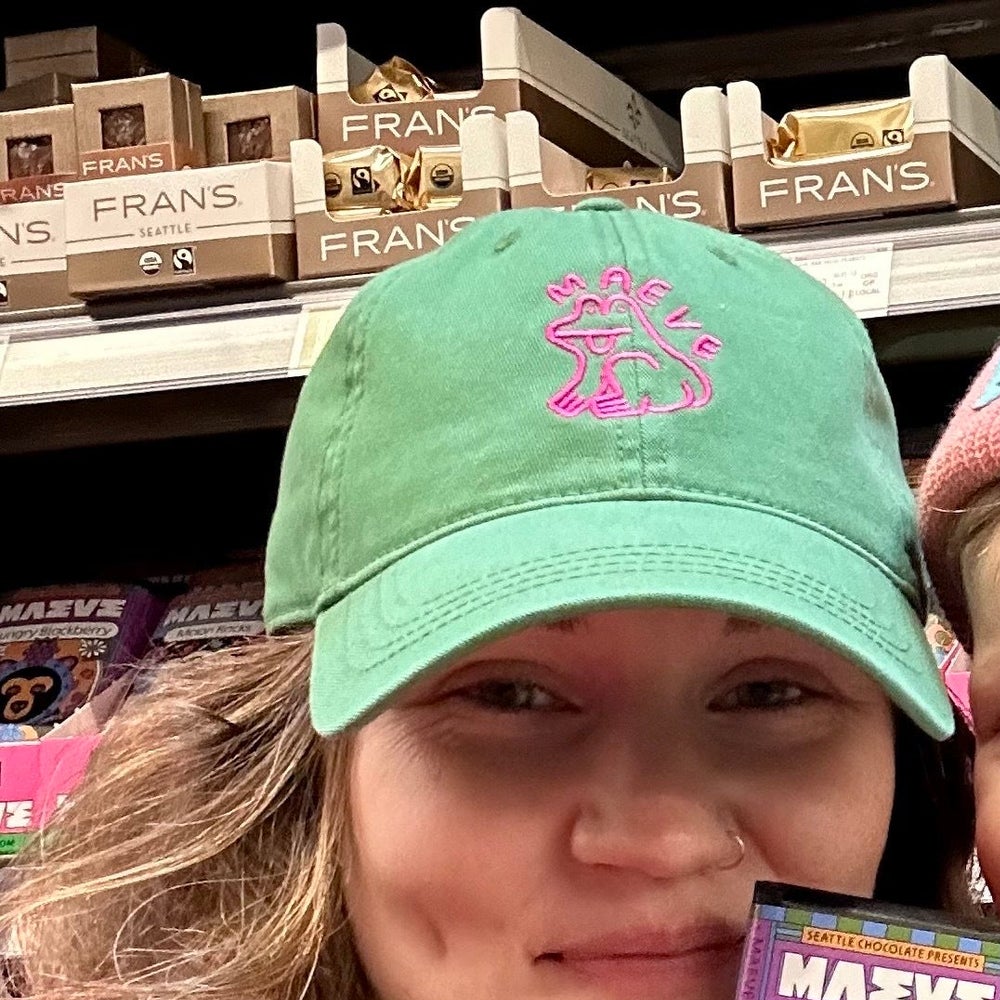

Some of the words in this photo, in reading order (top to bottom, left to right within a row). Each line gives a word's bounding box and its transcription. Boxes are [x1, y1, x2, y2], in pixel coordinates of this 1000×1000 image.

[82, 152, 164, 176] FRAN'S
[0, 182, 64, 202] RAN'S
[760, 161, 931, 208] FRAN'S
[93, 184, 238, 222] FRAN'S
[0, 220, 51, 246] N'S
[139, 222, 193, 239] SEATTLE
[547, 265, 723, 360] MAEVE
[0, 600, 126, 622] MAEVE
[163, 601, 264, 626] MAEV
[0, 628, 37, 640] ungry
[807, 929, 854, 948] SEATTLE
[858, 938, 925, 959] CHOCOLATE
[927, 950, 979, 968] PRESENTS
